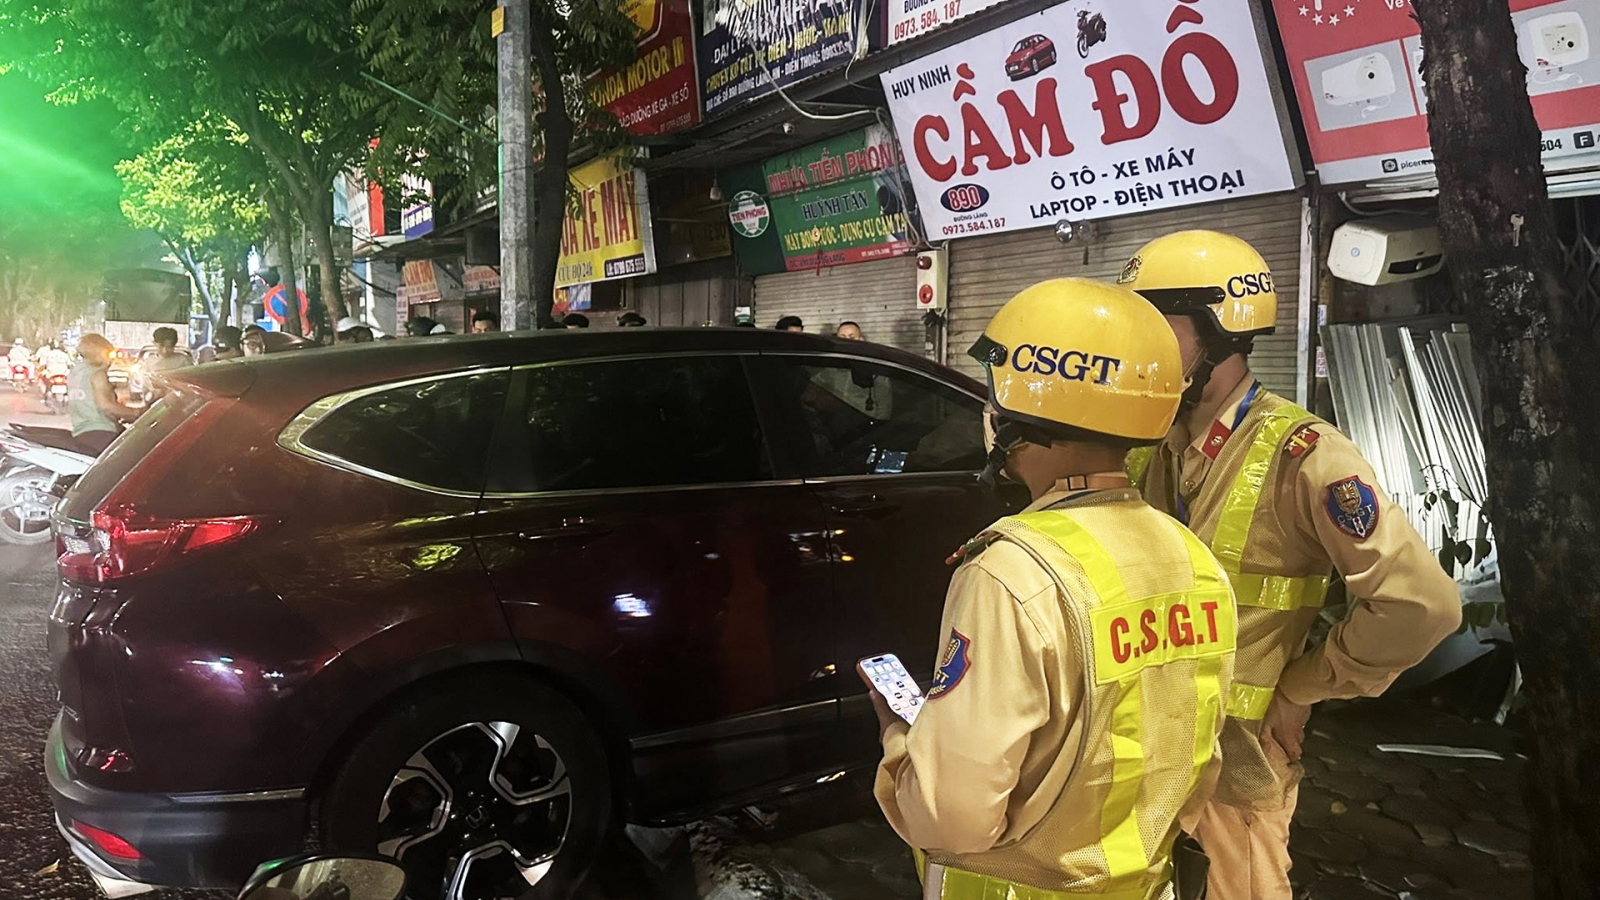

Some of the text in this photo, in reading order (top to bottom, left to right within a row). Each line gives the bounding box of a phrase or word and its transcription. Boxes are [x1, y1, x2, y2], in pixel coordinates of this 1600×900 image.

[944, 0, 961, 20] 187
[590, 72, 626, 108] ONDA
[627, 45, 671, 93] MOTOR
[891, 64, 952, 100] HUY NINH
[913, 63, 1075, 182] CẦM
[845, 138, 906, 174] PHON
[1050, 171, 1065, 190] Ô
[1069, 165, 1096, 187] TÔ
[1112, 160, 1140, 180] XE
[1145, 147, 1196, 173] MÁY
[948, 186, 981, 211] 890
[1030, 195, 1097, 219] LAPTOP
[1114, 182, 1164, 207] ĐIỆN
[1168, 169, 1246, 197] THOẠI
[579, 188, 601, 253] XE
[942, 217, 1006, 235] 0973.584.187
[1227, 272, 1277, 298] CSG
[1011, 343, 1121, 386] CSGT
[1110, 601, 1219, 664] C.S.G.T
